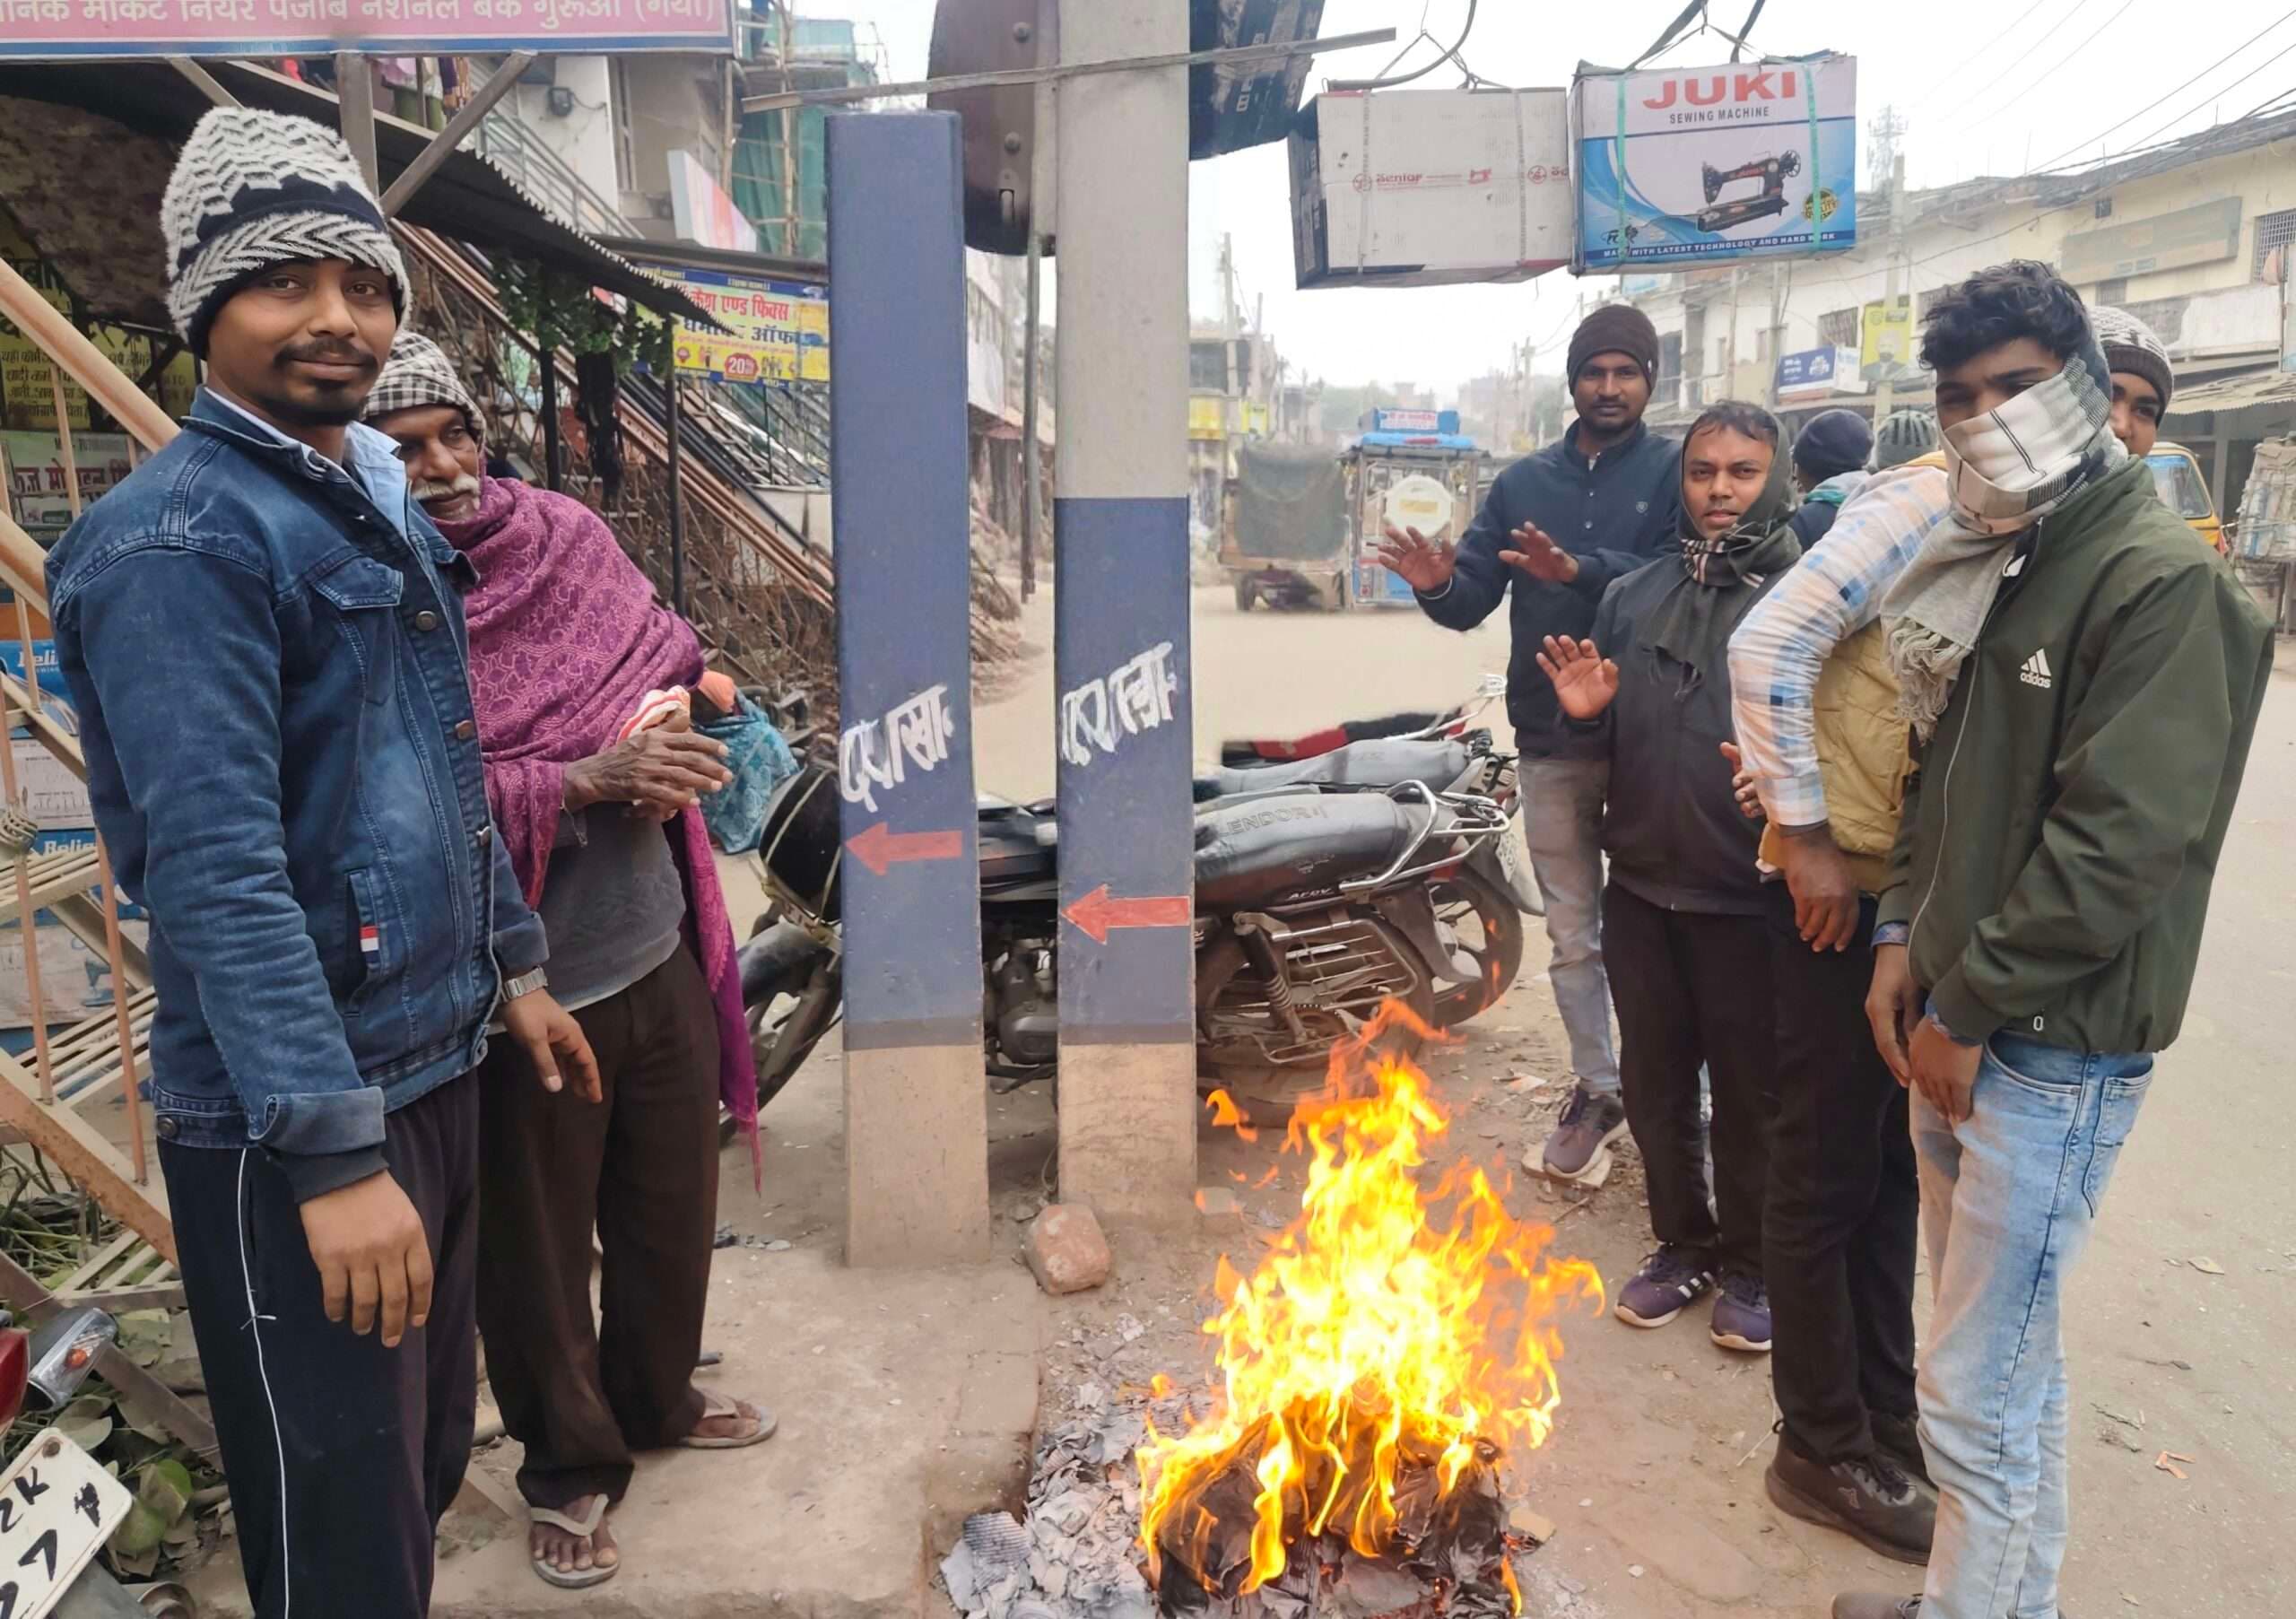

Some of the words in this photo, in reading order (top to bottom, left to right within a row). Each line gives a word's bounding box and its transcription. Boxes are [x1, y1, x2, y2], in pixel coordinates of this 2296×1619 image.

[1642, 71, 1796, 110] JUKI
[1669, 110, 1714, 124] SEWING
[1718, 107, 1770, 120] MACHINE
[1632, 248, 1656, 257] WITH
[1657, 245, 1692, 255] LATEST
[1694, 239, 1757, 252] TECHNOLOGY
[1758, 237, 1779, 246] AND
[2020, 671, 2052, 688] adidas
